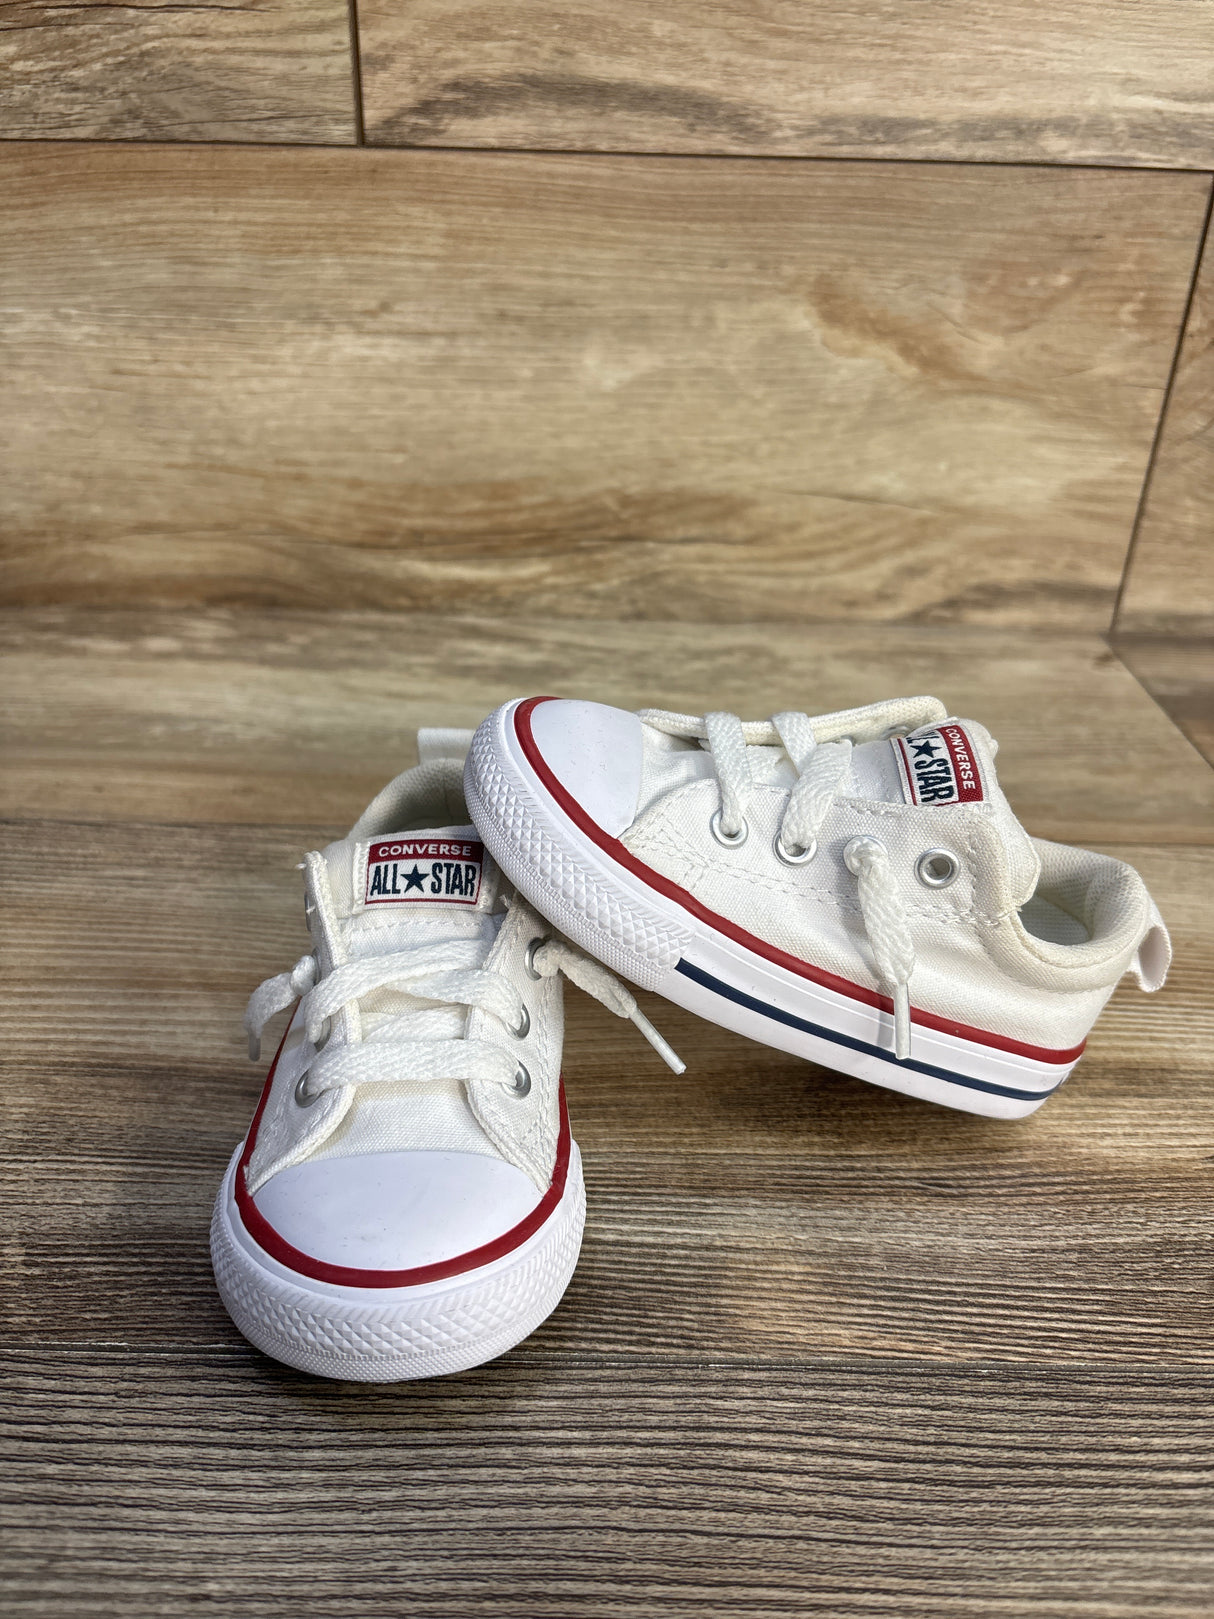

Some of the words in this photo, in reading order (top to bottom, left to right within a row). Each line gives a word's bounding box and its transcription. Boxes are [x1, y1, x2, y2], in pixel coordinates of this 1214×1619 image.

[945, 728, 976, 790] CONVERSE
[914, 758, 954, 802] STAR
[378, 843, 472, 857] CONVERSE
[370, 863, 401, 896] ALL
[430, 862, 477, 897] STAR
